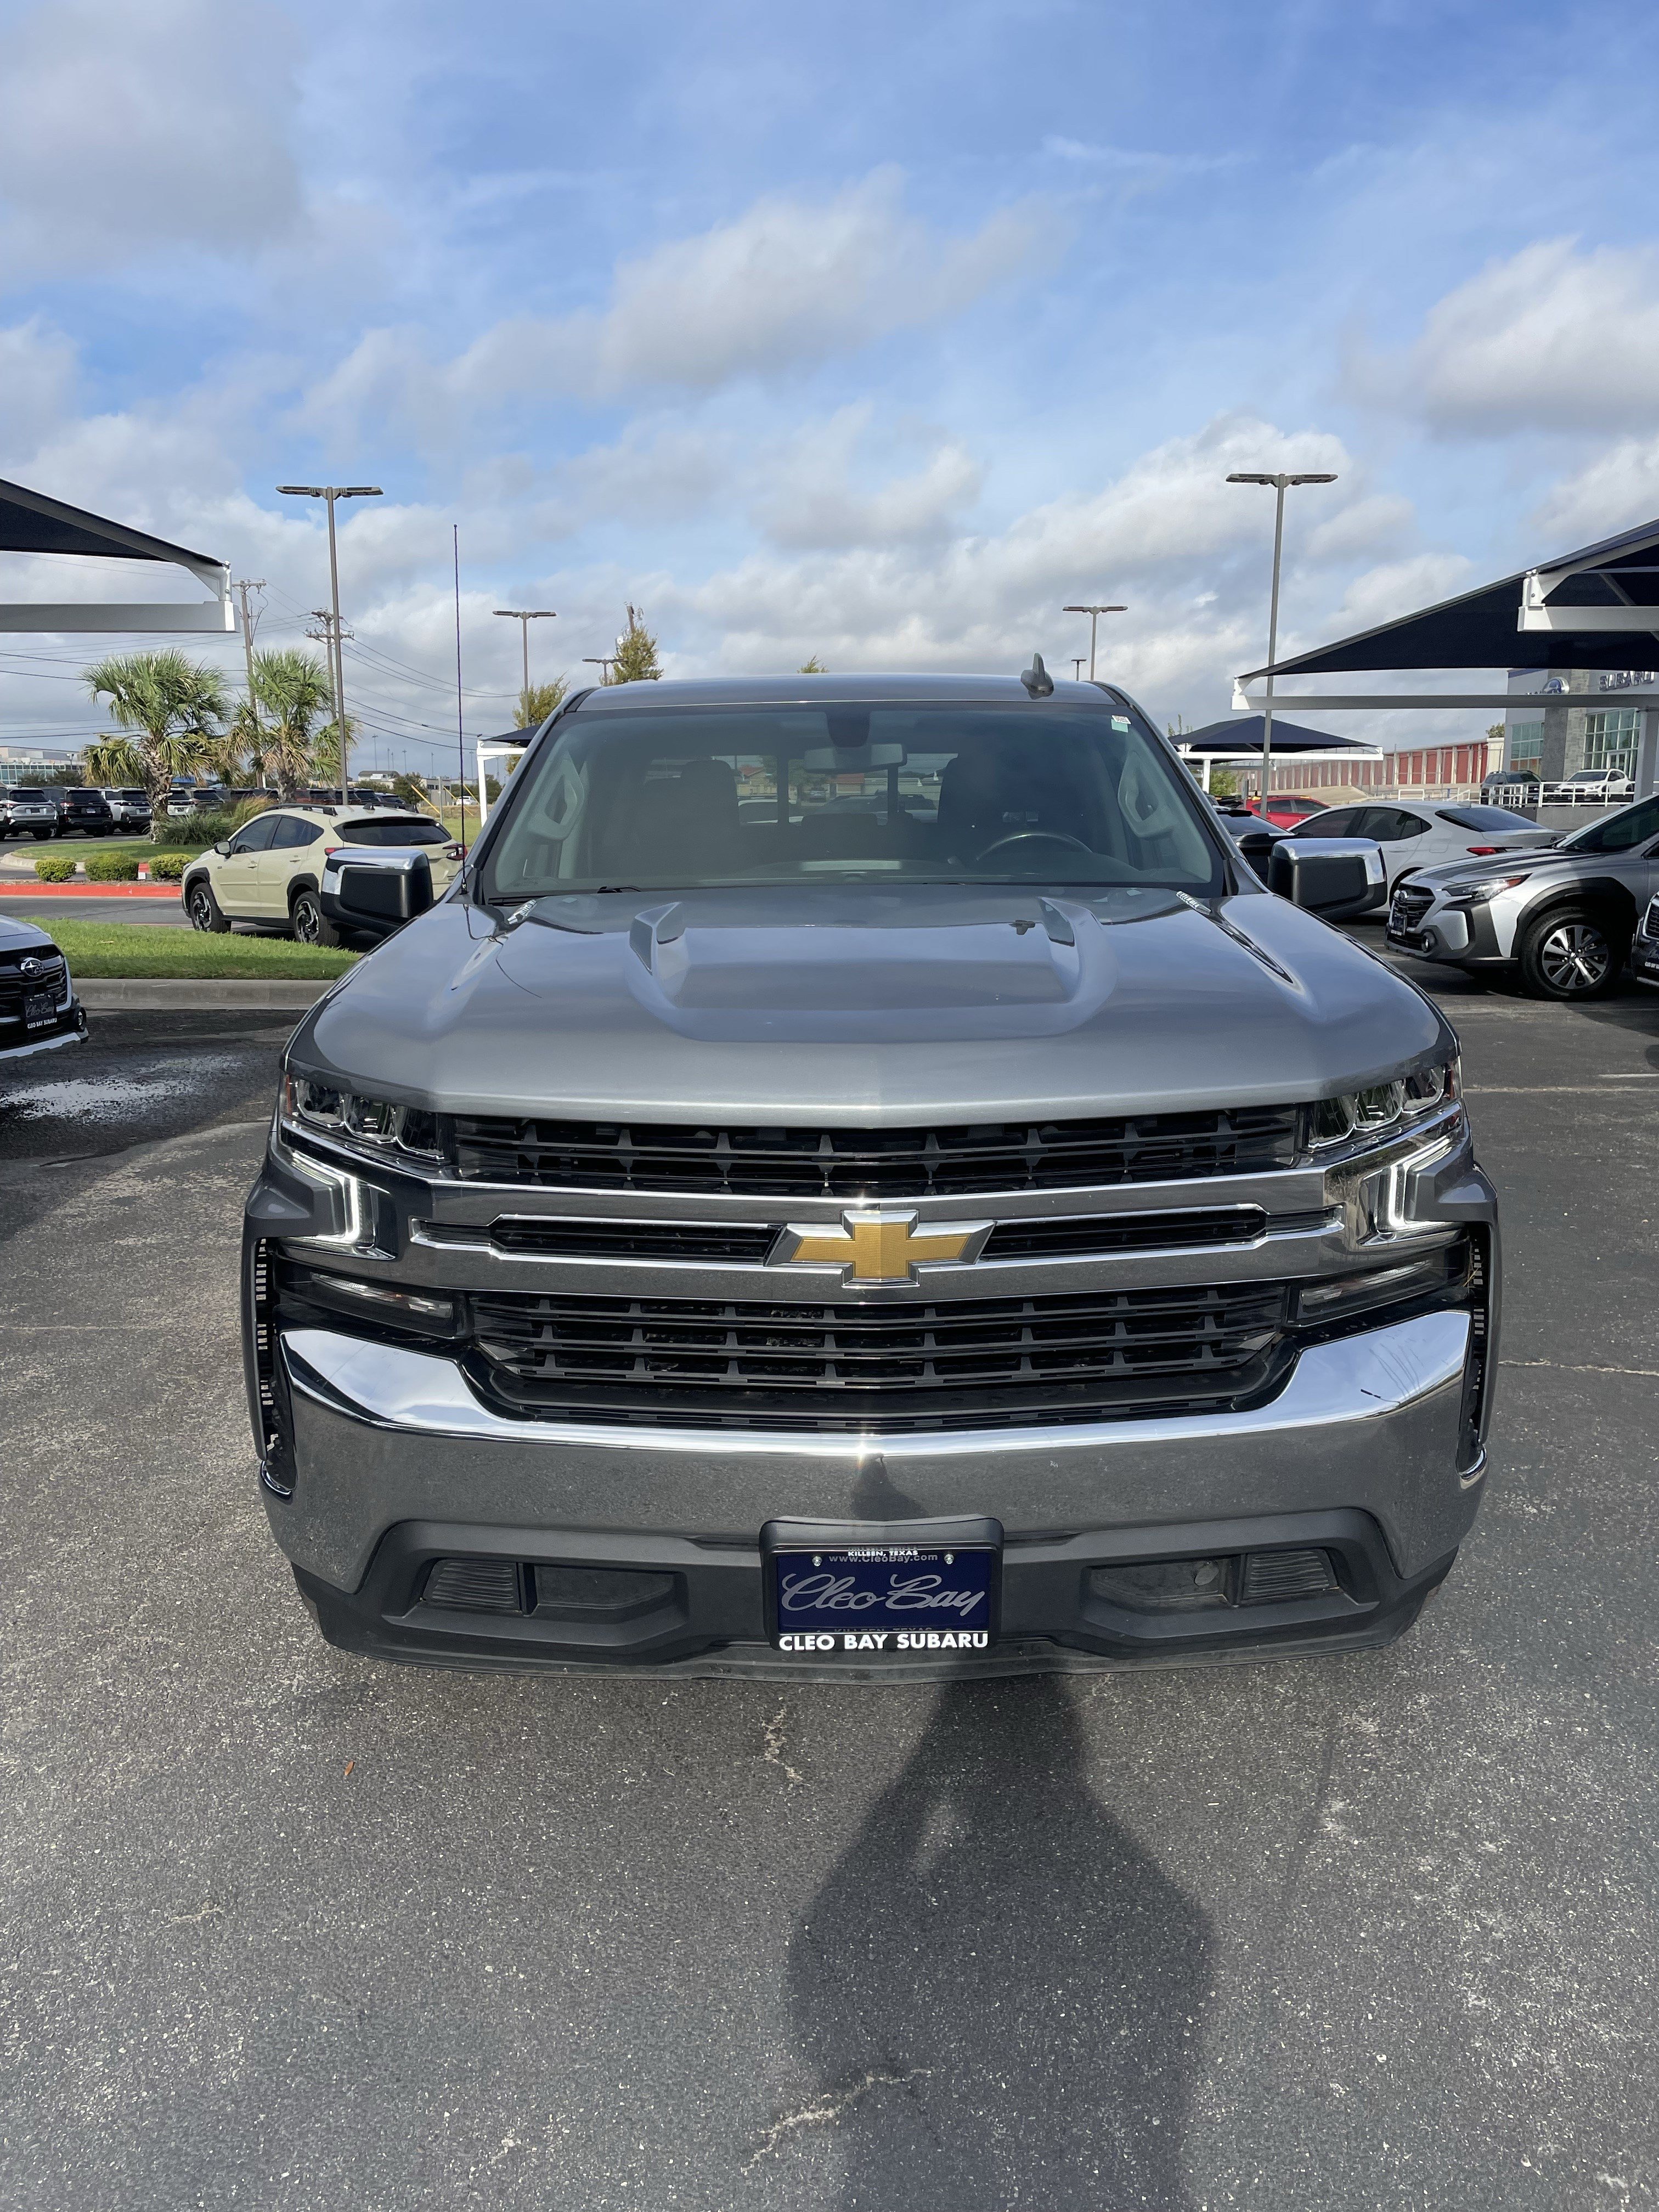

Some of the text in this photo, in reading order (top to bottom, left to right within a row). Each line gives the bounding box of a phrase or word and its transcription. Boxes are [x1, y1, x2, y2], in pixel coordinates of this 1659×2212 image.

[828, 1553, 938, 1563] www.CleoBay.com
[781, 1573, 985, 1616] Cleo Bay
[778, 1633, 988, 1651] CLEO BAY SUBARU
